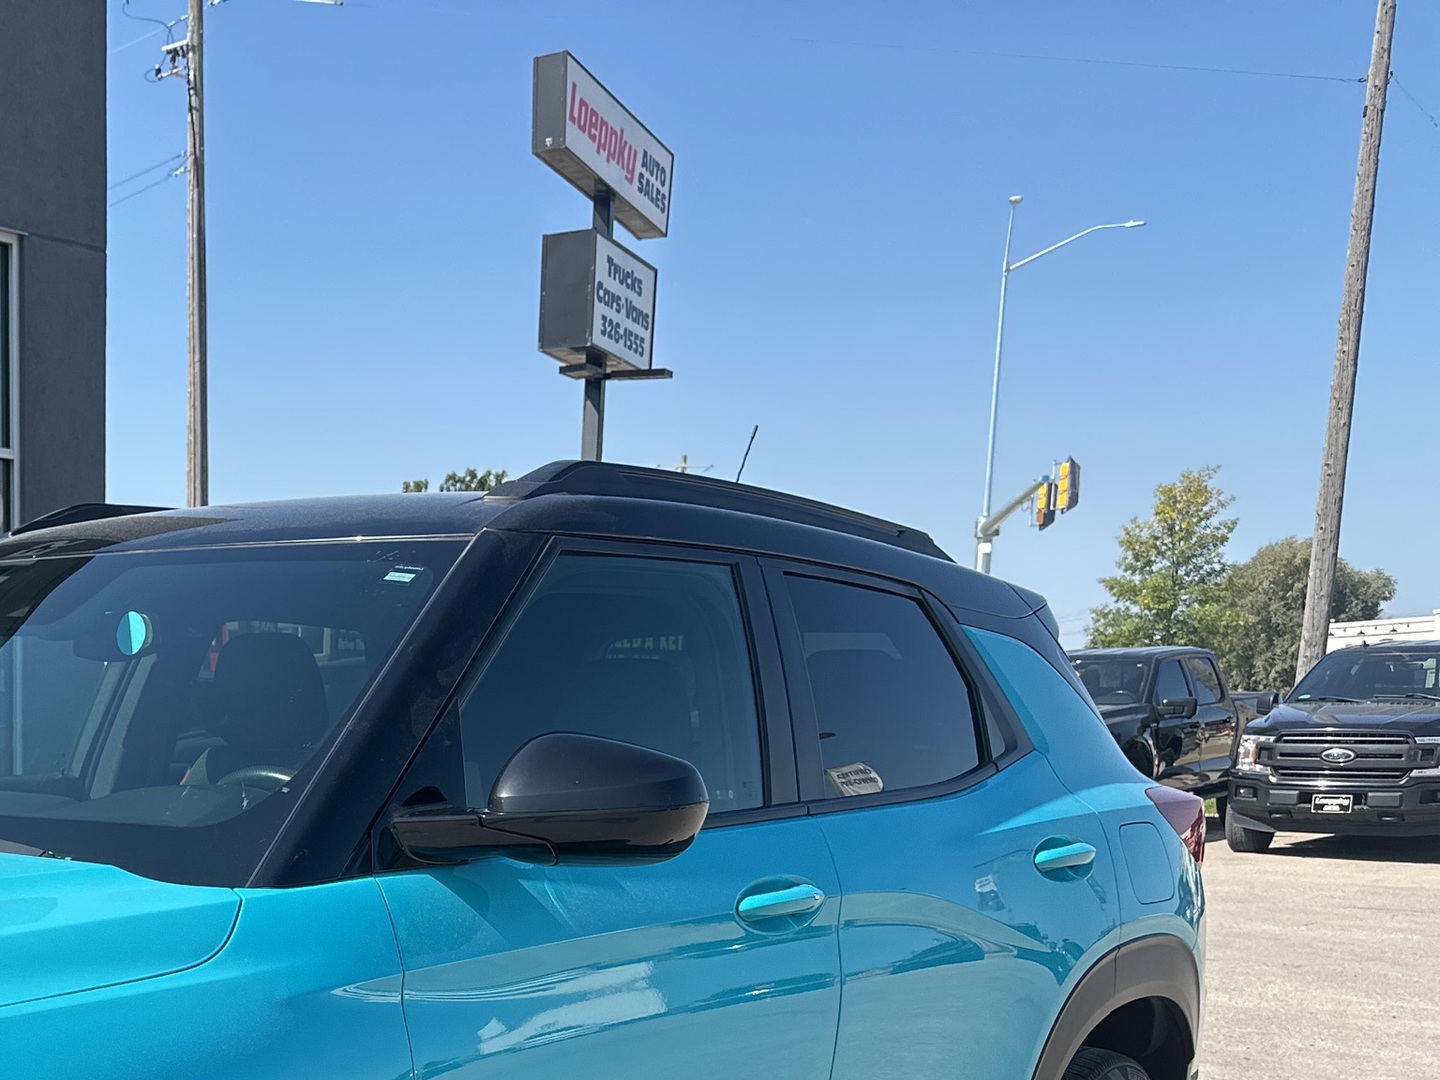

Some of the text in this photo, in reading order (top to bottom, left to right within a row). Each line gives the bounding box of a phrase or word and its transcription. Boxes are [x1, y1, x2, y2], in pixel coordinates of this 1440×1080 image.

[568, 82, 638, 186] Loeppky
[641, 148, 667, 188] AUTO
[637, 175, 667, 214] SALES
[606, 255, 643, 297] Trucks
[600, 314, 645, 358] 326-1555
